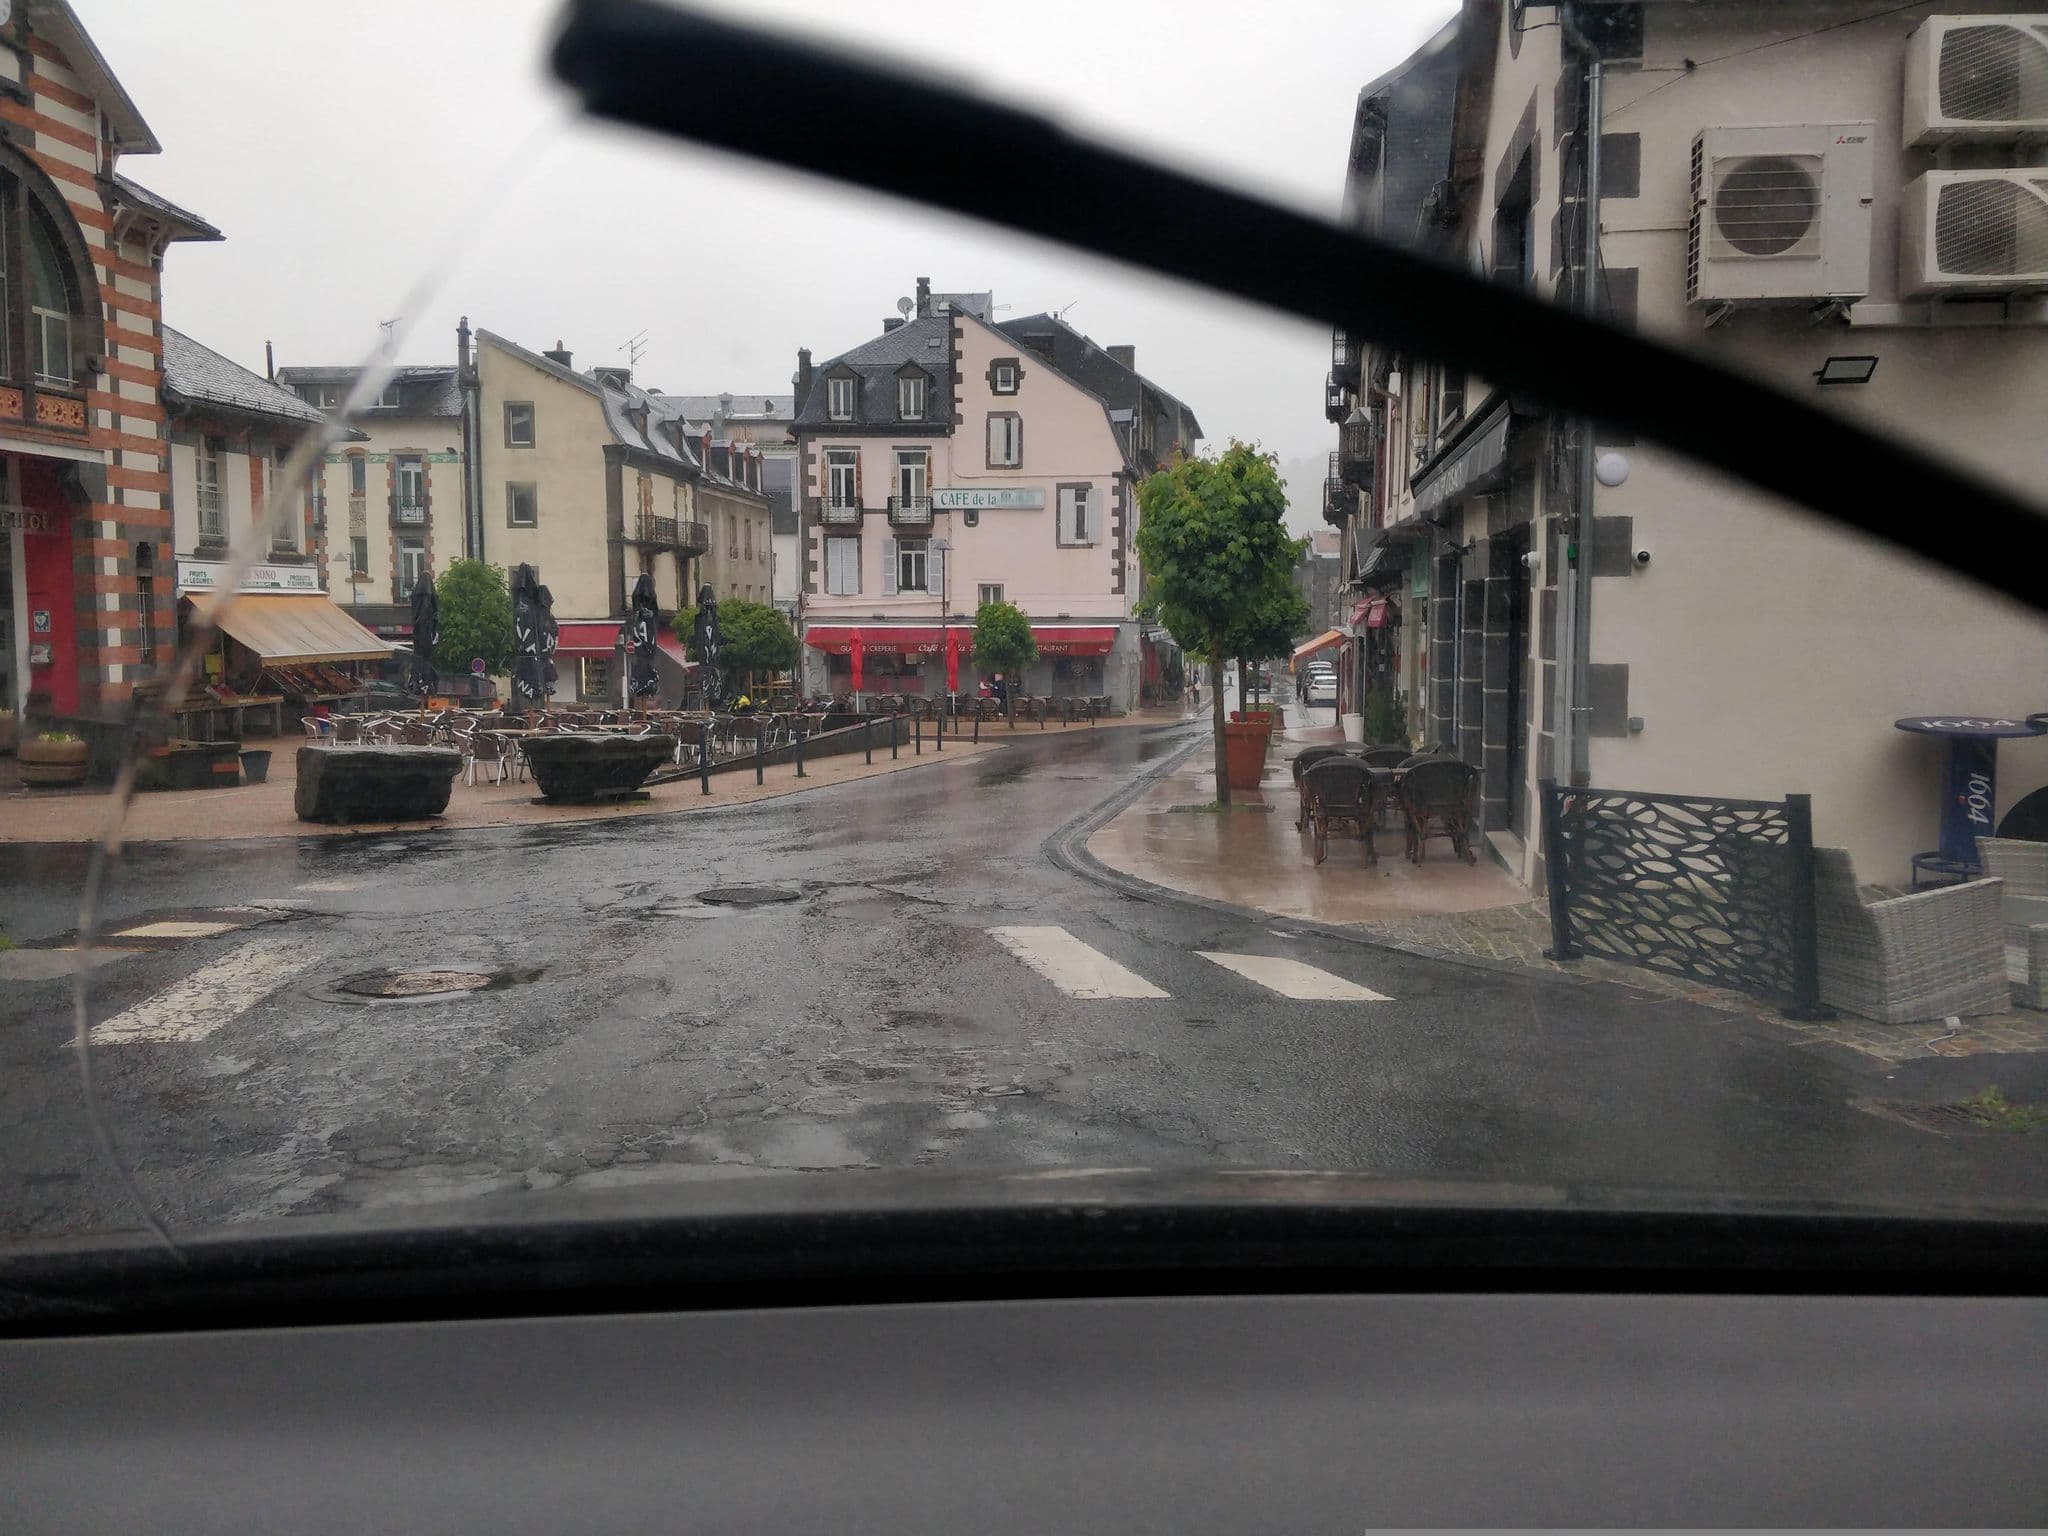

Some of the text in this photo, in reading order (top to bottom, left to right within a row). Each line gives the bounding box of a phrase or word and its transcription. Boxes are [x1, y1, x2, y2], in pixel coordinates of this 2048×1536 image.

[973, 493, 985, 505] de
[988, 493, 997, 505] la
[1921, 719, 2015, 729] 1664
[1967, 773, 1992, 824] 1664
